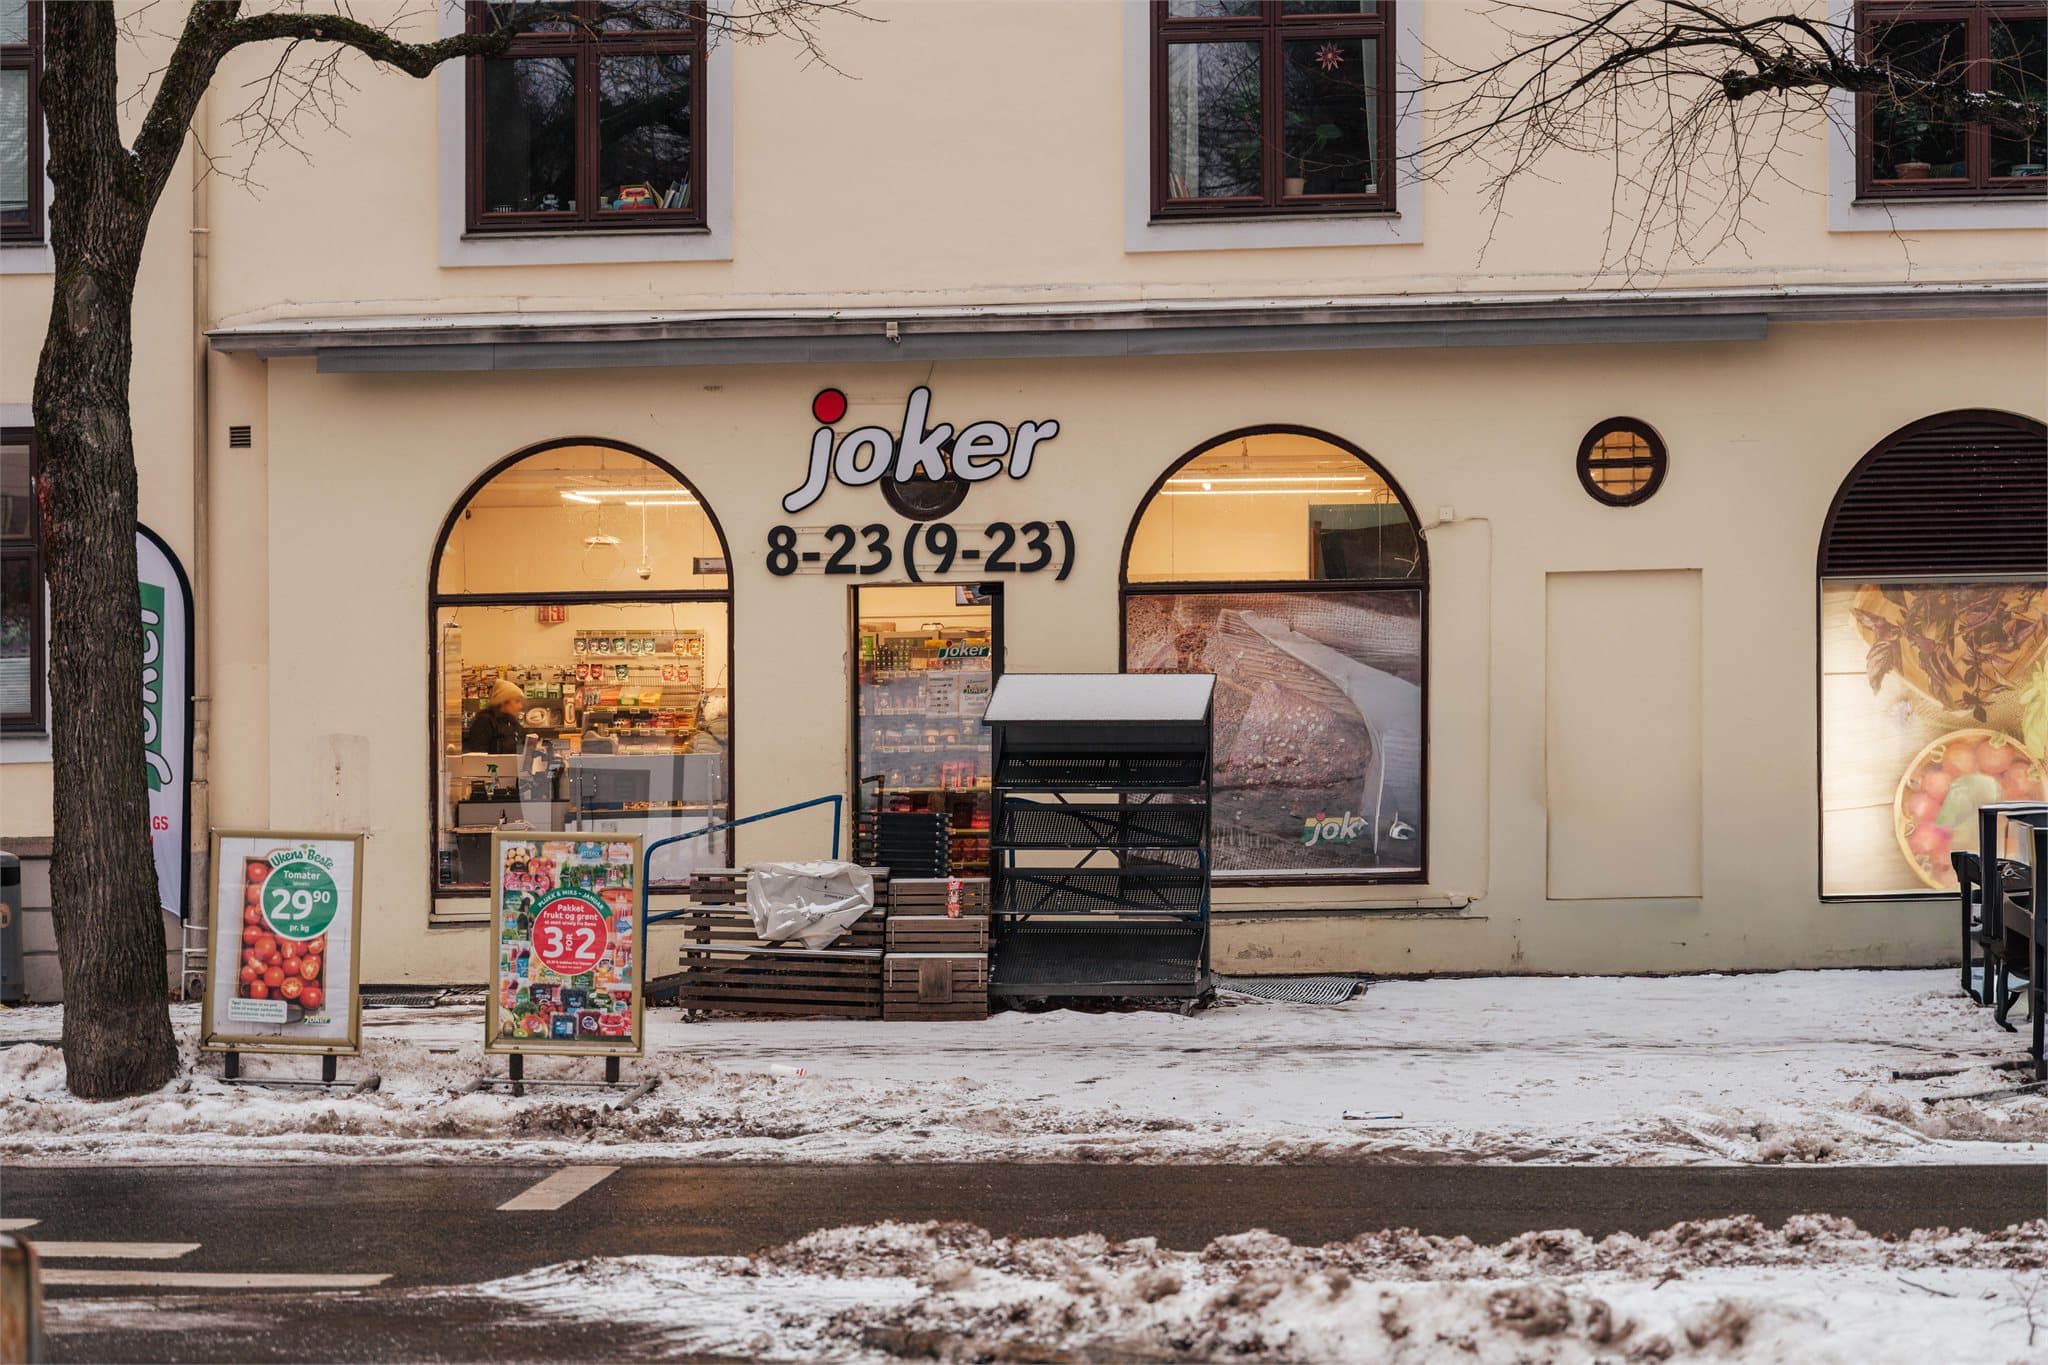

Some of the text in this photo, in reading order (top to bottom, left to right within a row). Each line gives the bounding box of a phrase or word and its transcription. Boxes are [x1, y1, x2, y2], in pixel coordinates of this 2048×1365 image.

[782, 386, 1060, 514] joker
[765, 520, 1075, 582] 8-23 (9-23)
[942, 640, 988, 659] joker
[270, 849, 334, 870] Ukens Beste
[284, 870, 321, 880] Tomater
[543, 911, 564, 920] frukt
[557, 904, 585, 913] Pakket
[289, 924, 310, 932] pr. kg
[543, 926, 563, 958] 3
[575, 928, 595, 959] 2
